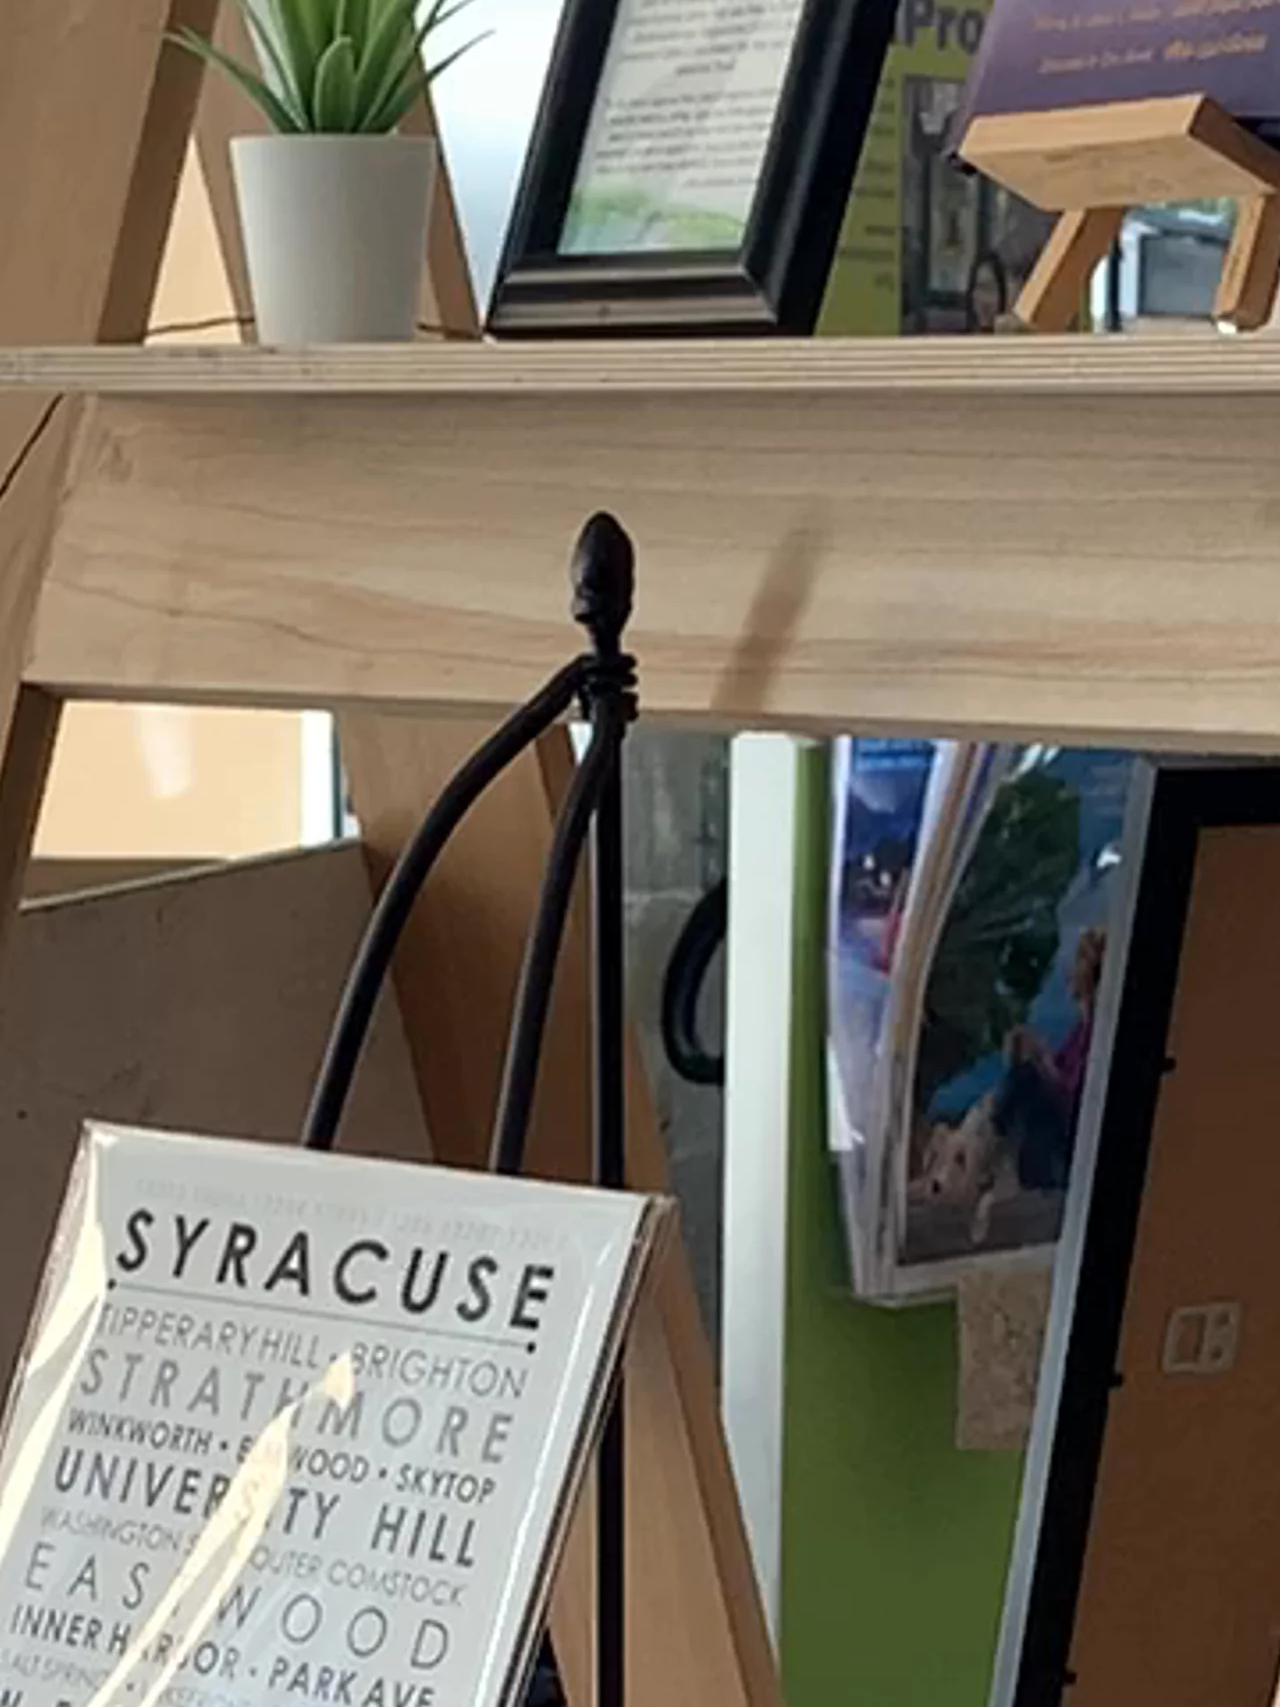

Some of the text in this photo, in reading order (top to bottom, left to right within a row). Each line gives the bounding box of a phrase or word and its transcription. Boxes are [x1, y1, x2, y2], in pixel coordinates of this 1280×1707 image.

[116, 1207, 556, 1331] SYRACUSE
[97, 1302, 529, 1400] TIPPERARY HILL BRIGHTON
[67, 1407, 214, 1457] WINKWORTH
[395, 1461, 497, 1506] SKYTOP
[80, 1348, 514, 1465] STRATHMORE
[40, 1505, 181, 1553] WASHINGTON
[250, 1544, 322, 1580] OUTER
[327, 1557, 468, 1608] COMSTOCK
[54, 1446, 477, 1569] UNIVERSTY HILL
[10, 1603, 103, 1647] INNER
[107, 1623, 240, 1680] HROR
[268, 1655, 352, 1707] PARK
[23, 1541, 450, 1671] EASWOOD
